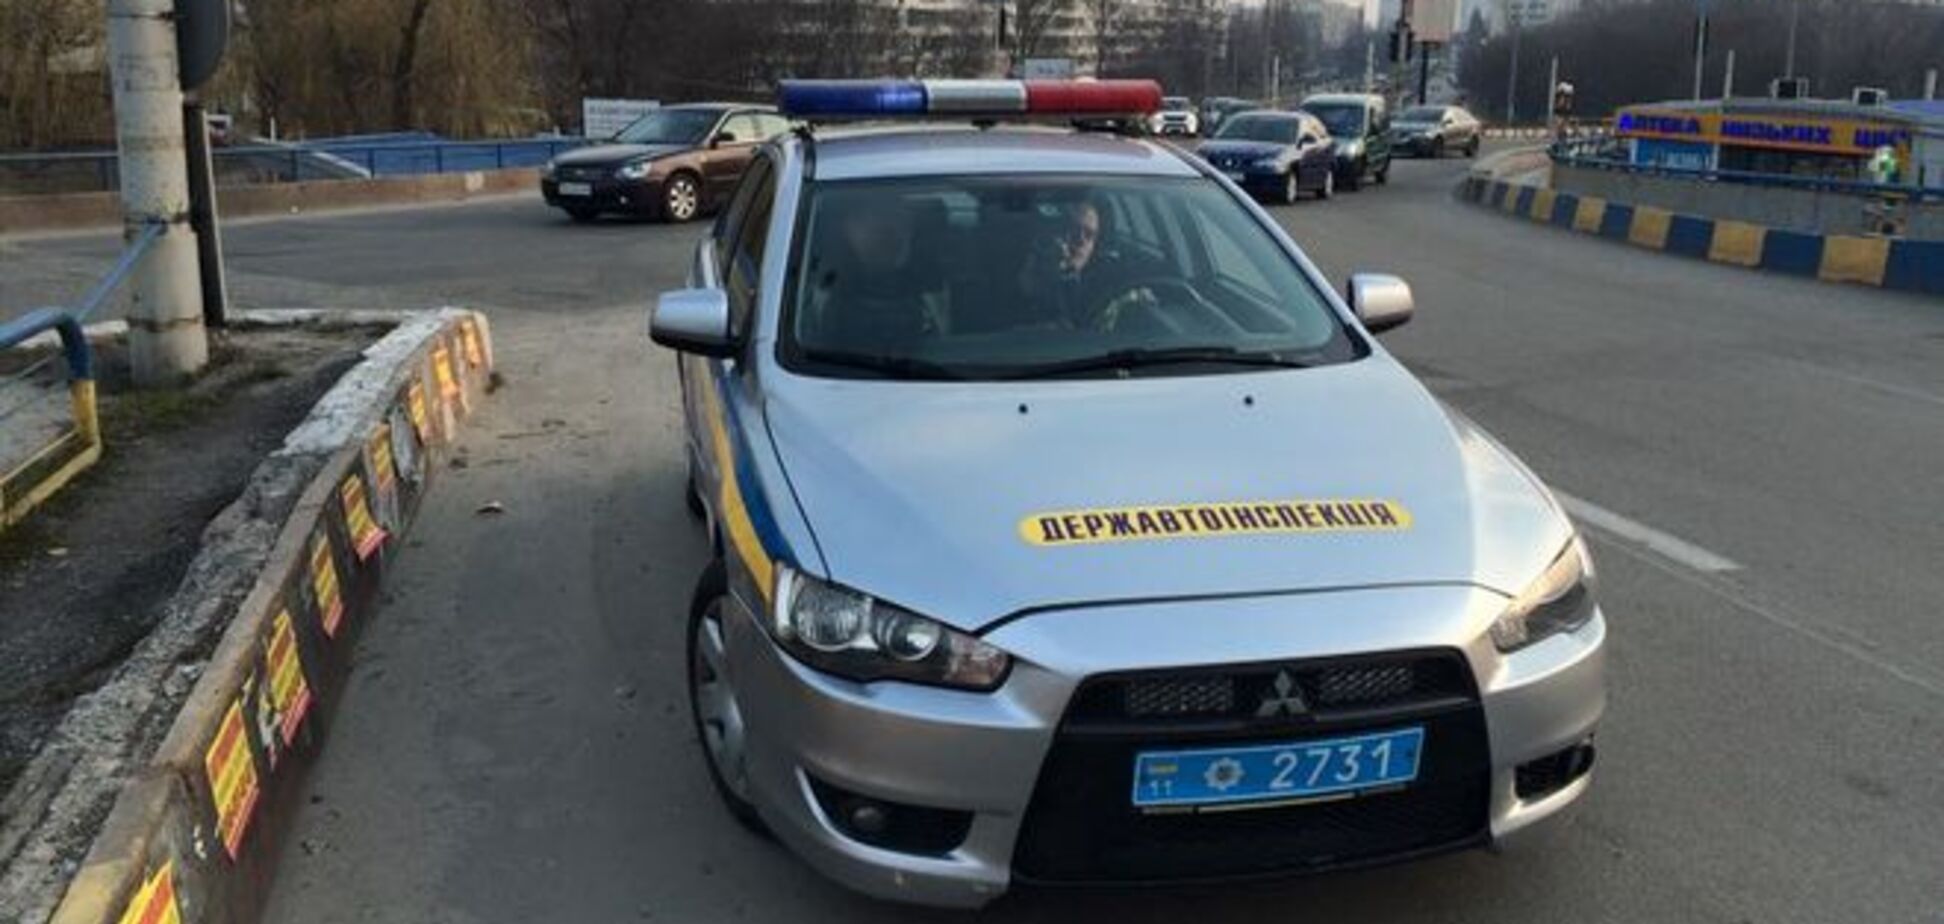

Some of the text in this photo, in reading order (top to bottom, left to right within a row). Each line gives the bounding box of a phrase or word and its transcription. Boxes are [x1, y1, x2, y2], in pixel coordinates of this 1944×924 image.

[1619, 113, 1701, 134] АПТЕКА
[1038, 501, 1399, 544] ДЕРЖАВТОІНСПЕКЦІЯ
[1269, 738, 1394, 789] 2731
[1150, 779, 1173, 797] 11
